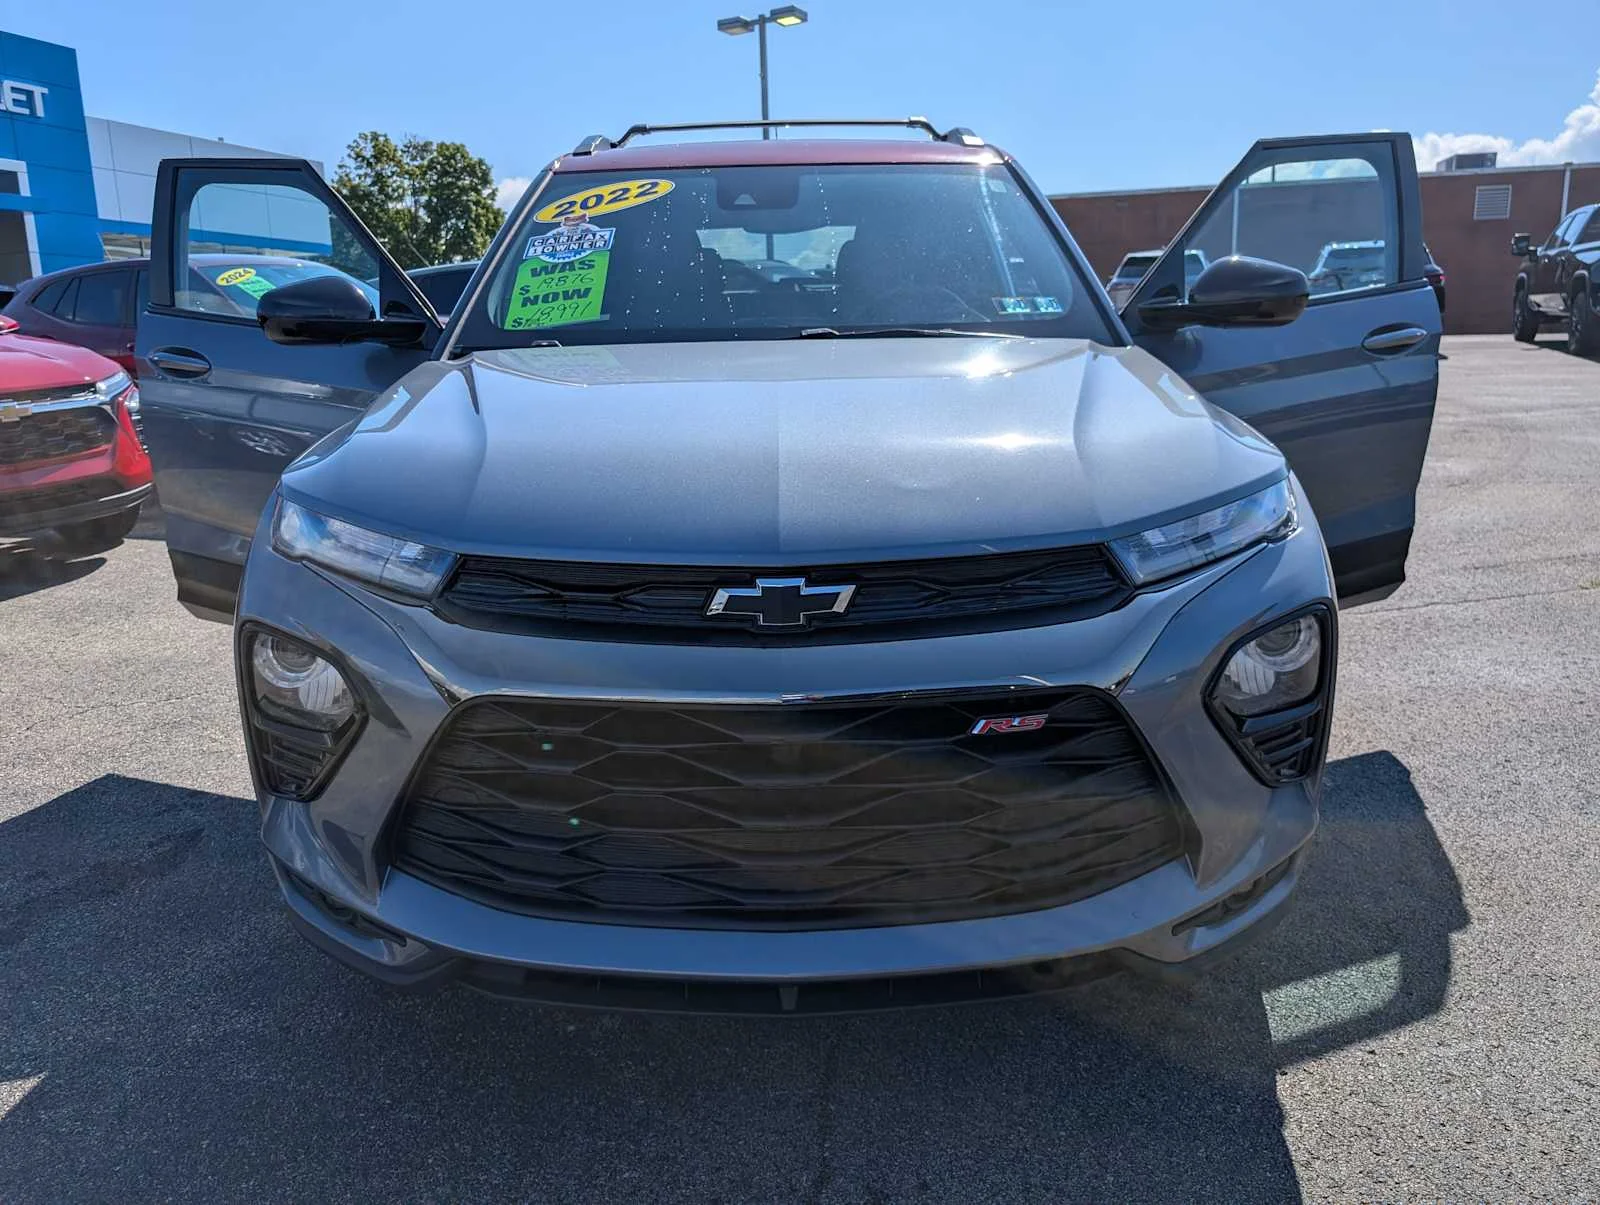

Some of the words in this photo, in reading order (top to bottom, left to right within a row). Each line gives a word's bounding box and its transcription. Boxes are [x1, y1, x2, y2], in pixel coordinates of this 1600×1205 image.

[552, 181, 659, 219] 2022
[533, 231, 608, 246] CARFAX
[543, 240, 605, 253] OWNER
[530, 259, 595, 278] WAS
[521, 287, 593, 308] NOW
[971, 713, 1048, 735] RS
